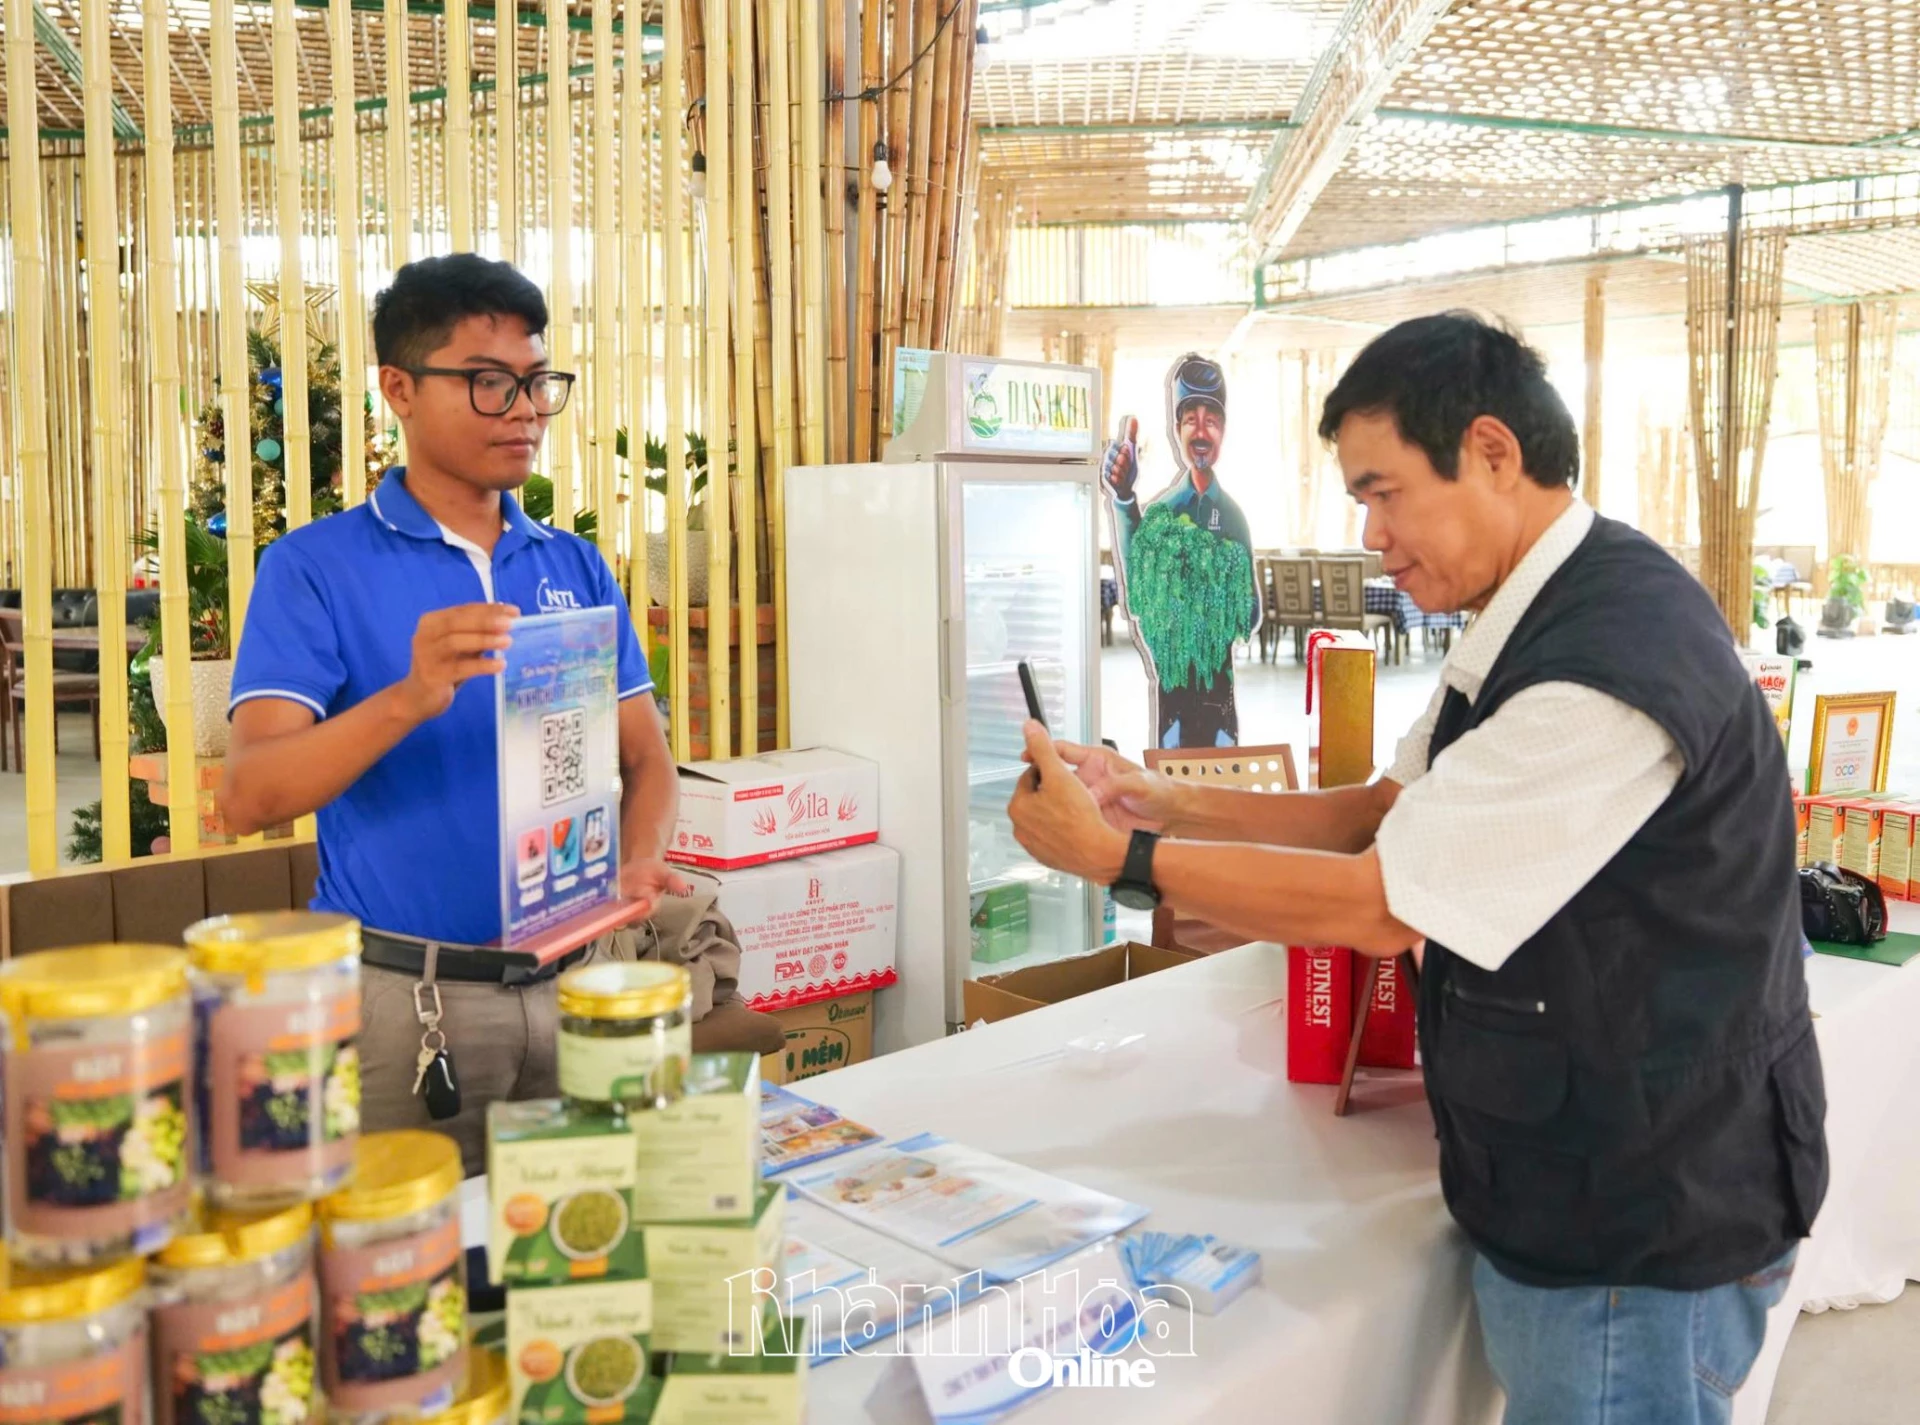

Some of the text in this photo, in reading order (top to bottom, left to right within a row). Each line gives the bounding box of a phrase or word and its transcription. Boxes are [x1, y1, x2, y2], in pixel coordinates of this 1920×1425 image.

[545, 588, 581, 608] NTL
[692, 834, 714, 848] FDA
[775, 959, 805, 981] FDA
[1312, 957, 1332, 1028] DTNEST
[1377, 957, 1396, 1013] TNEST
[801, 1035, 843, 1069] MỀM
